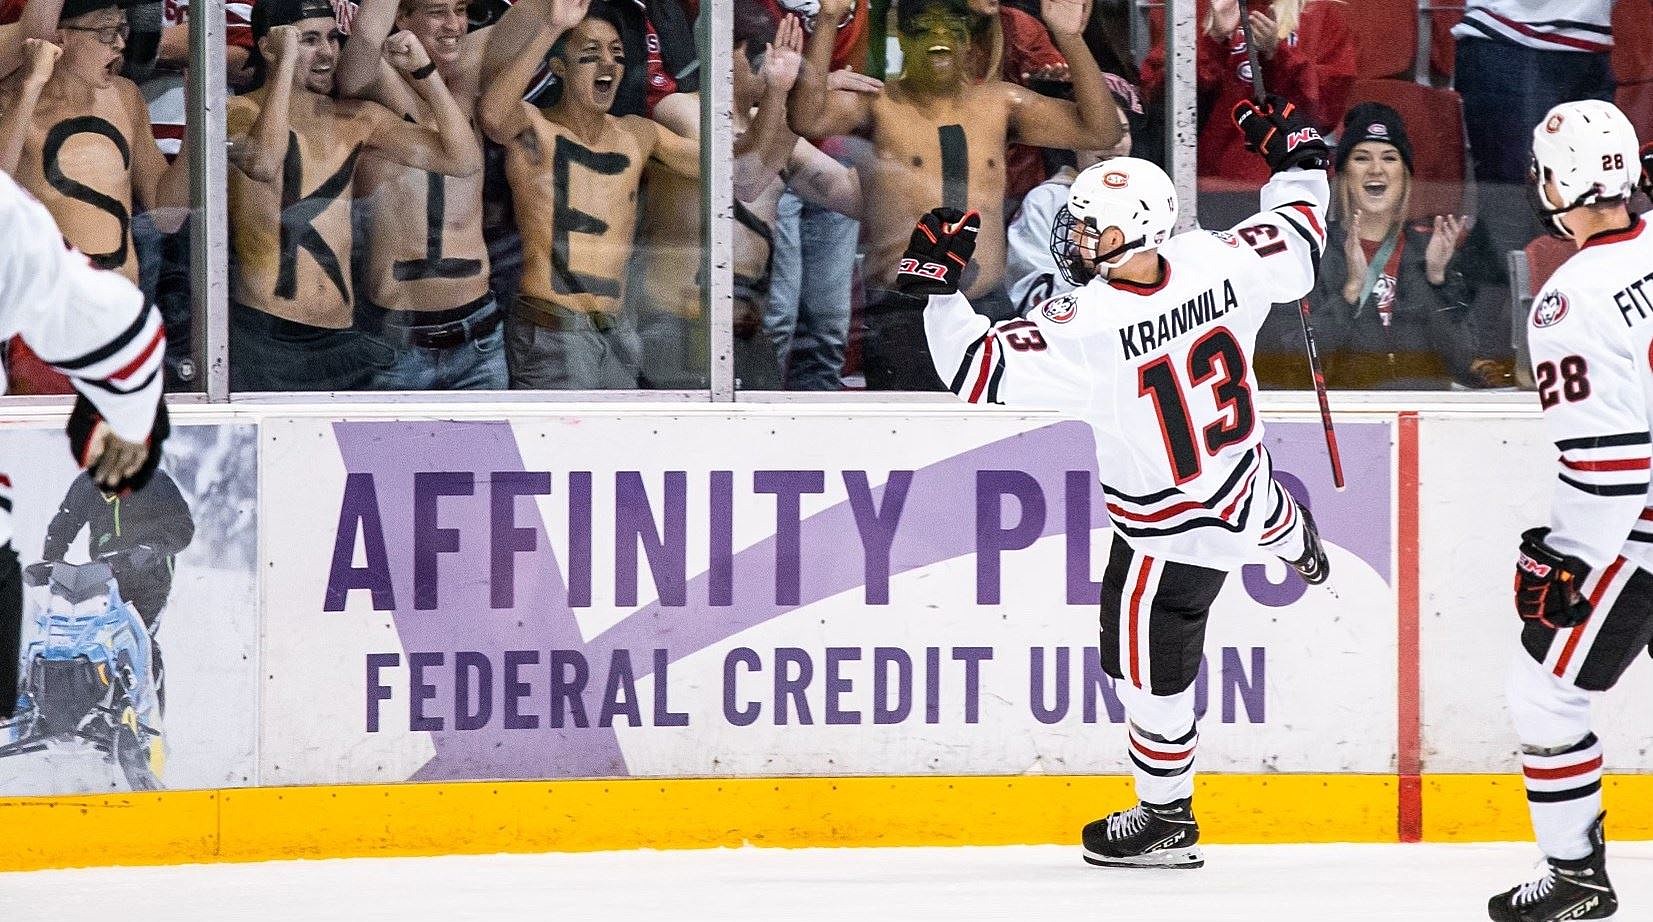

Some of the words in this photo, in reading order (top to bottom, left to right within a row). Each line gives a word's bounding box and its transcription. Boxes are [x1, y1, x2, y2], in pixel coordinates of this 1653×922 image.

[1602, 153, 1624, 171] 28
[43, 115, 129, 269] S
[274, 130, 363, 306] K
[552, 134, 631, 300] E
[1238, 223, 1288, 259] 13
[996, 320, 1047, 352] 13
[1119, 278, 1239, 361] KRANNILA
[1137, 325, 1256, 487] 13
[1536, 354, 1591, 413] 28
[323, 470, 915, 612] AFFINITY
[976, 470, 1311, 607] PLS
[366, 648, 689, 732] FEDERAL
[723, 646, 993, 727] CREDIT
